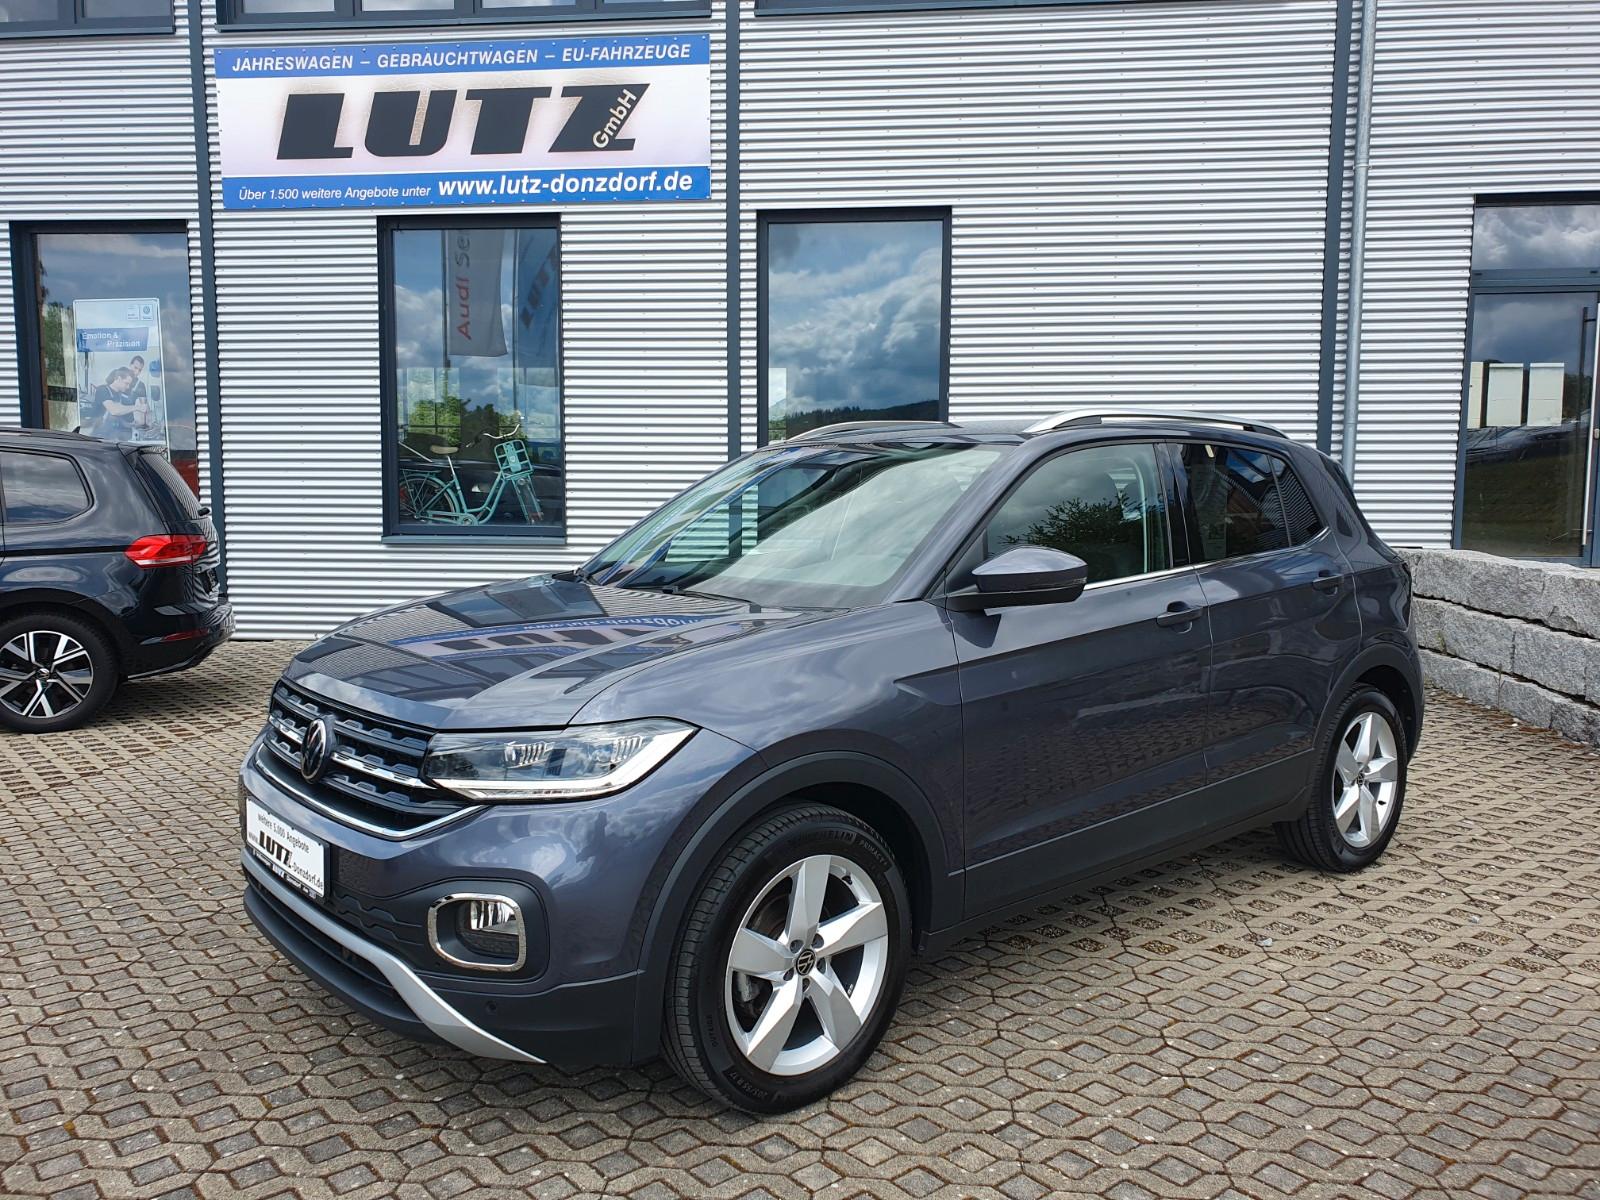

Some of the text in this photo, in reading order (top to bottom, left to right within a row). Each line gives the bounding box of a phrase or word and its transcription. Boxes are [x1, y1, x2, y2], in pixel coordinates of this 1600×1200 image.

[232, 55, 353, 72] JAHRESWAGEN
[377, 49, 538, 68] GEBRAUCHTWAGEN
[562, 43, 691, 62] EU-FAHRZEUGE
[276, 83, 650, 160] LUTZ
[592, 88, 637, 149] GmbH
[239, 171, 693, 201] Über 1.500 weitere Angebote unter www.lutz-donzdorf.de
[454, 229, 472, 340] Audi Se
[286, 831, 310, 854] Angebote
